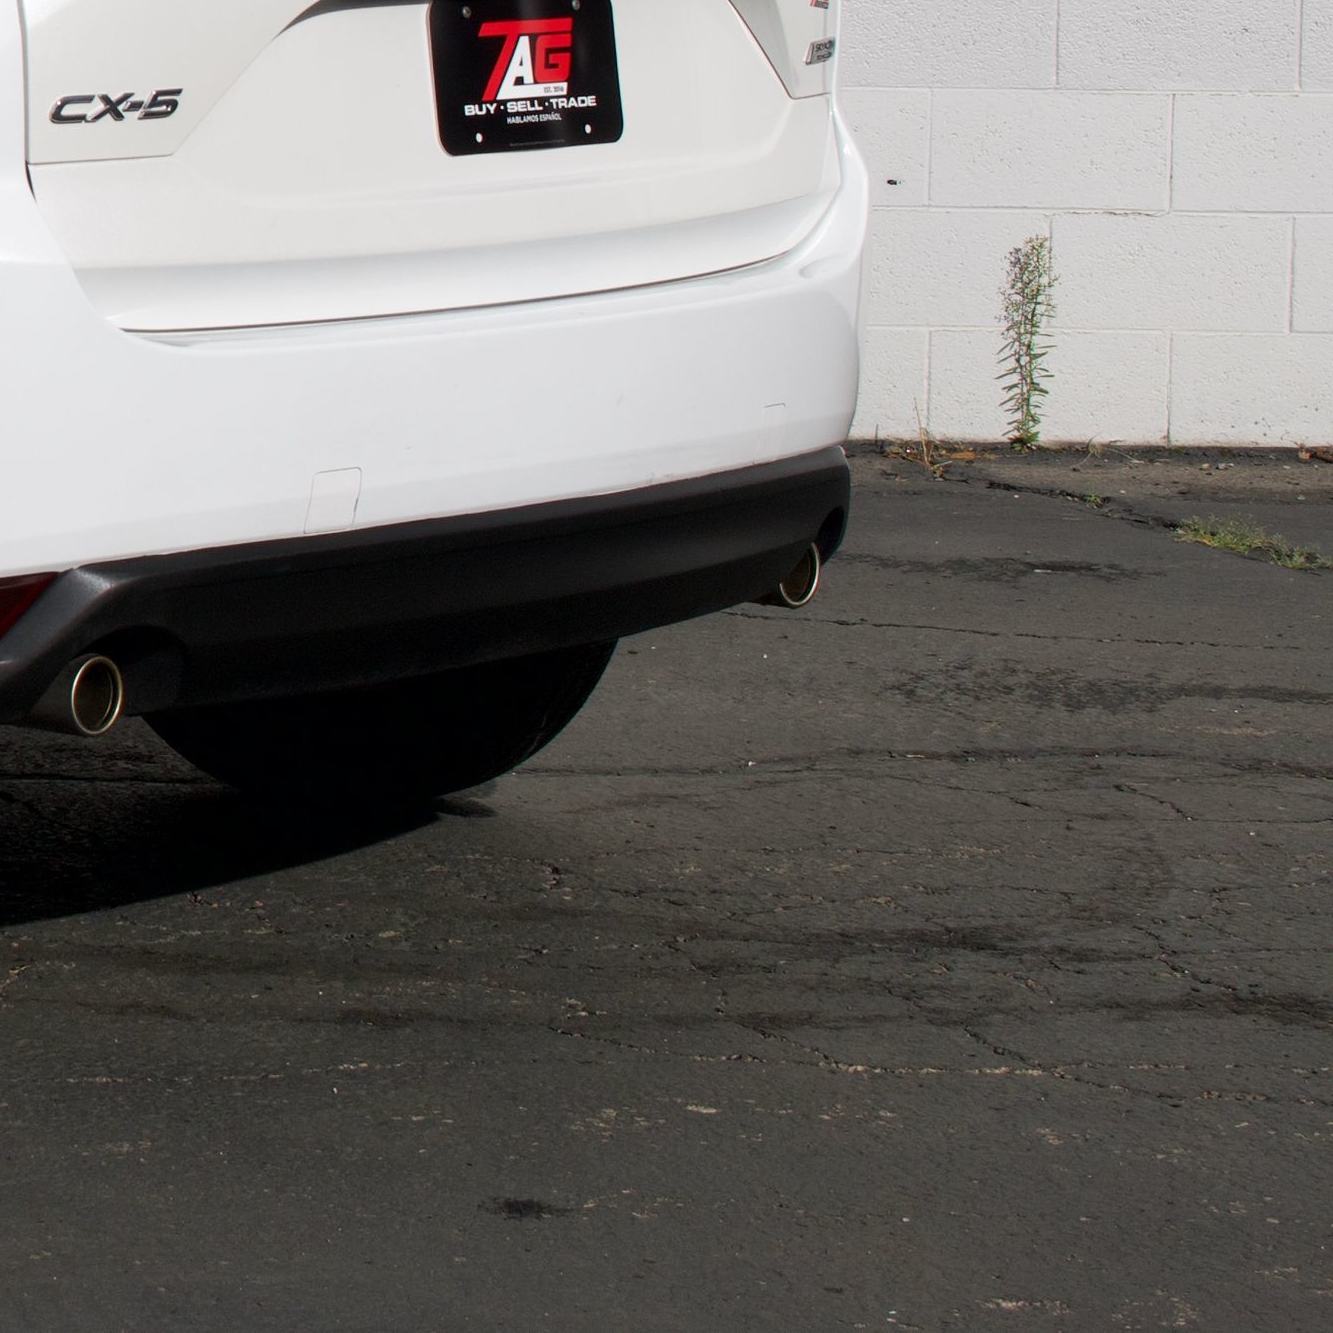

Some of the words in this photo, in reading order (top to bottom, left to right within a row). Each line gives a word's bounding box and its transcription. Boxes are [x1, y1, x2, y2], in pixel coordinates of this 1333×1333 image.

[478, 18, 572, 101] TAG
[49, 88, 183, 124] CX-5
[464, 103, 497, 116] BUY
[506, 99, 543, 113] SELL
[550, 95, 597, 109] TRADE
[507, 114, 539, 124] HABLAMOS
[539, 112, 562, 122] ESPAÑOL
